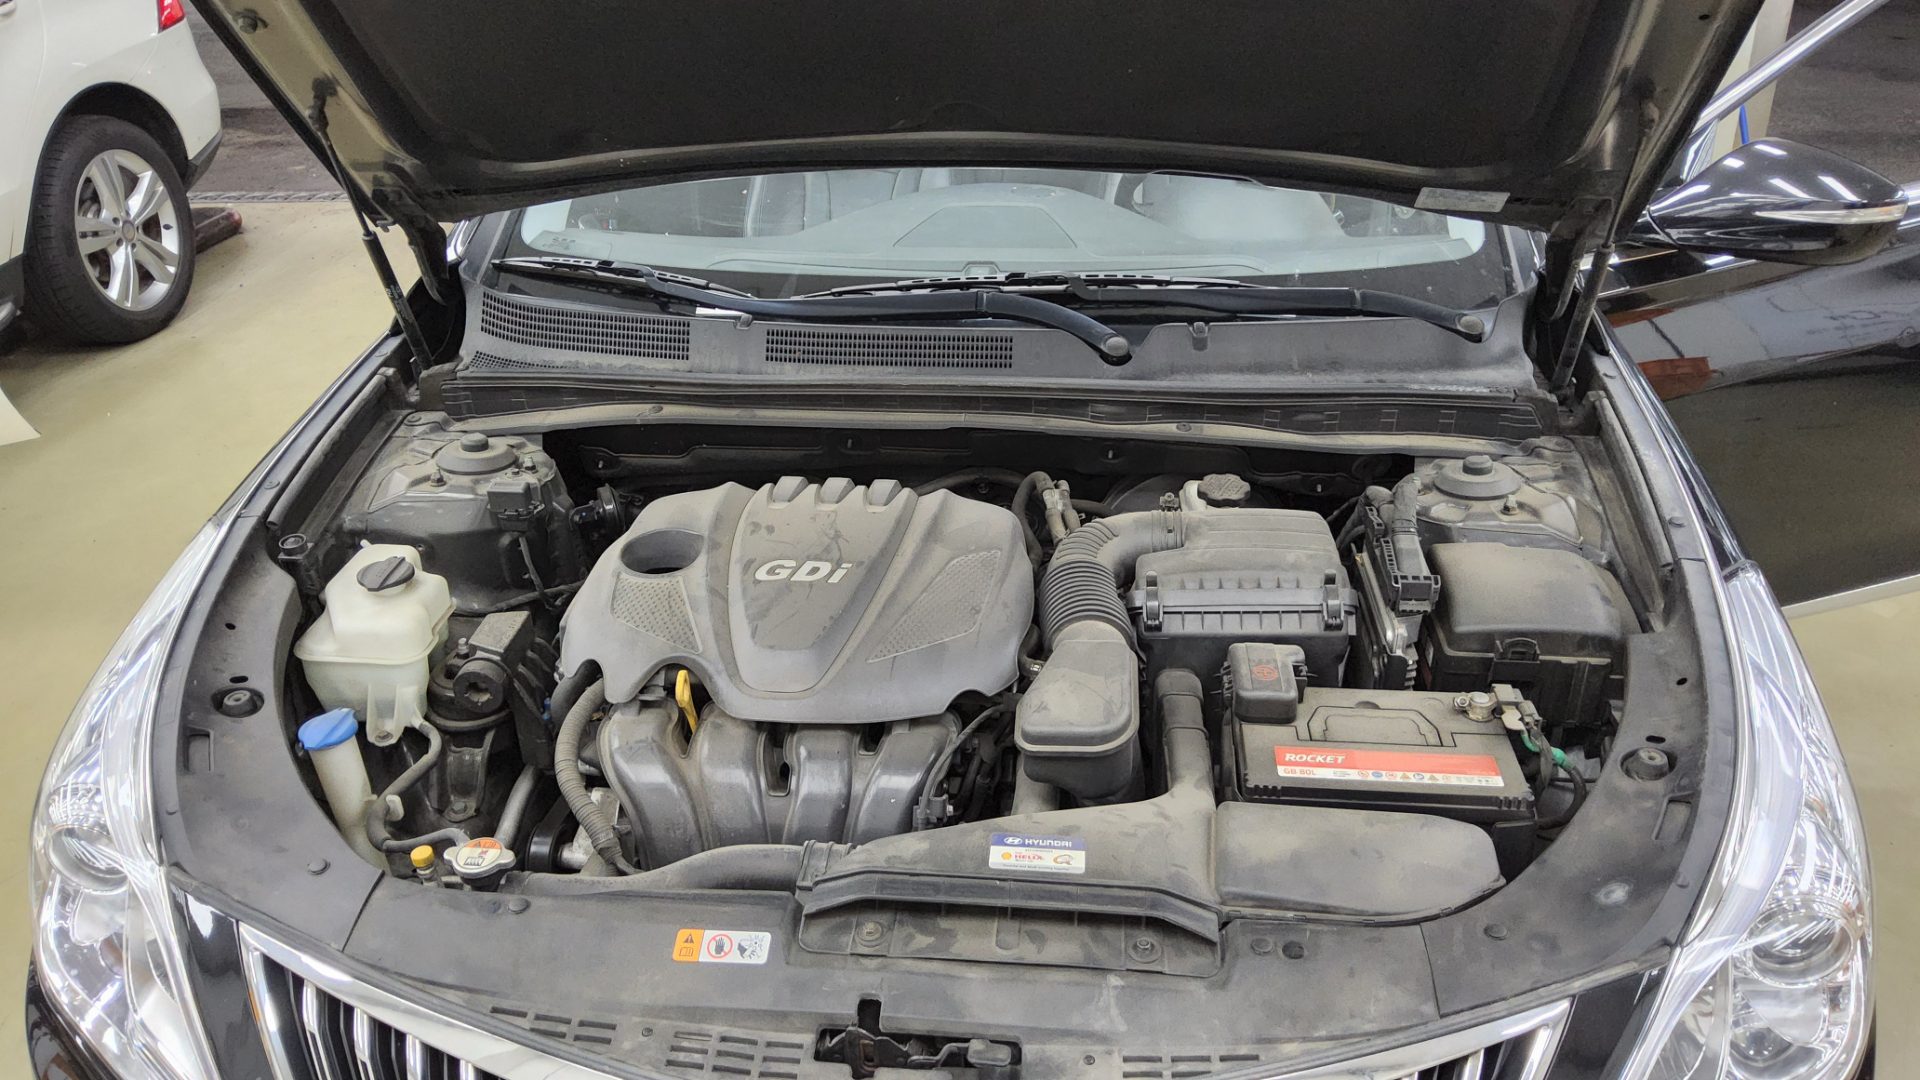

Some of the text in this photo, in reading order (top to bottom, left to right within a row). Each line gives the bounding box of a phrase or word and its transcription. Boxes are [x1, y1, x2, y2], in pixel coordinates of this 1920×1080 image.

[755, 560, 852, 583] GDi
[1285, 753, 1345, 764] ROCKET
[1025, 838, 1072, 848] HYUNDAI
